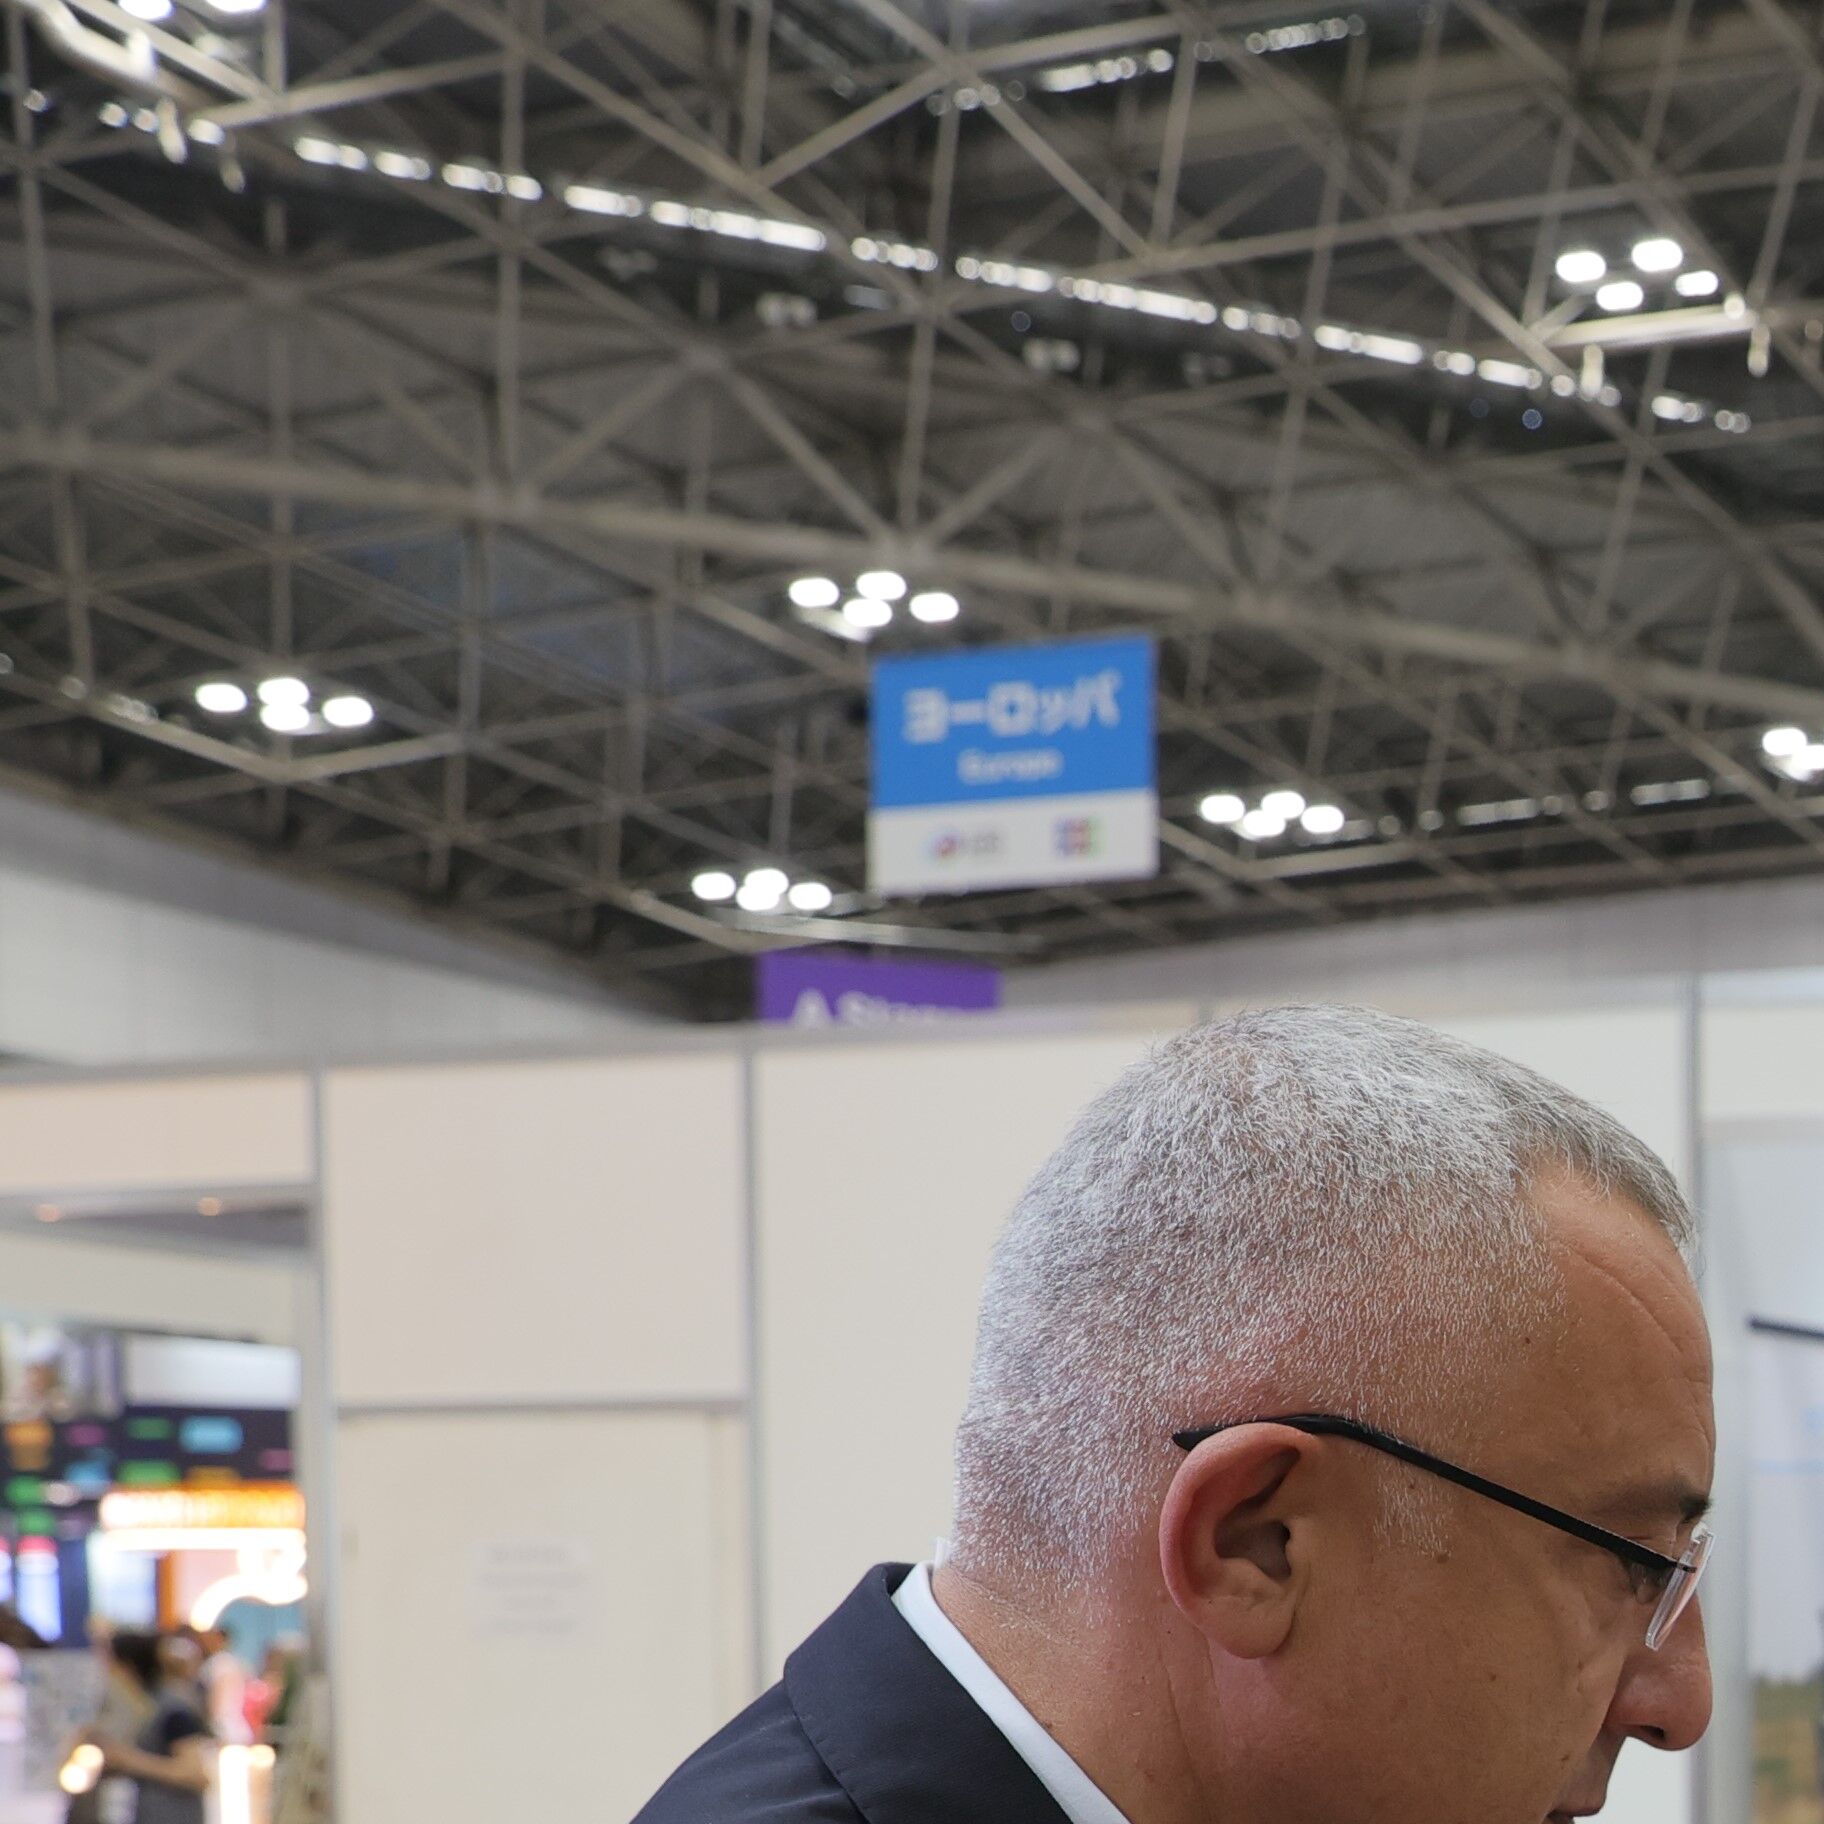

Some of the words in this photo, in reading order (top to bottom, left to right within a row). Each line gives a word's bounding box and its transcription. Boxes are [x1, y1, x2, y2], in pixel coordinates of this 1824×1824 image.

[904, 667, 1123, 743] ヨーロッパ
